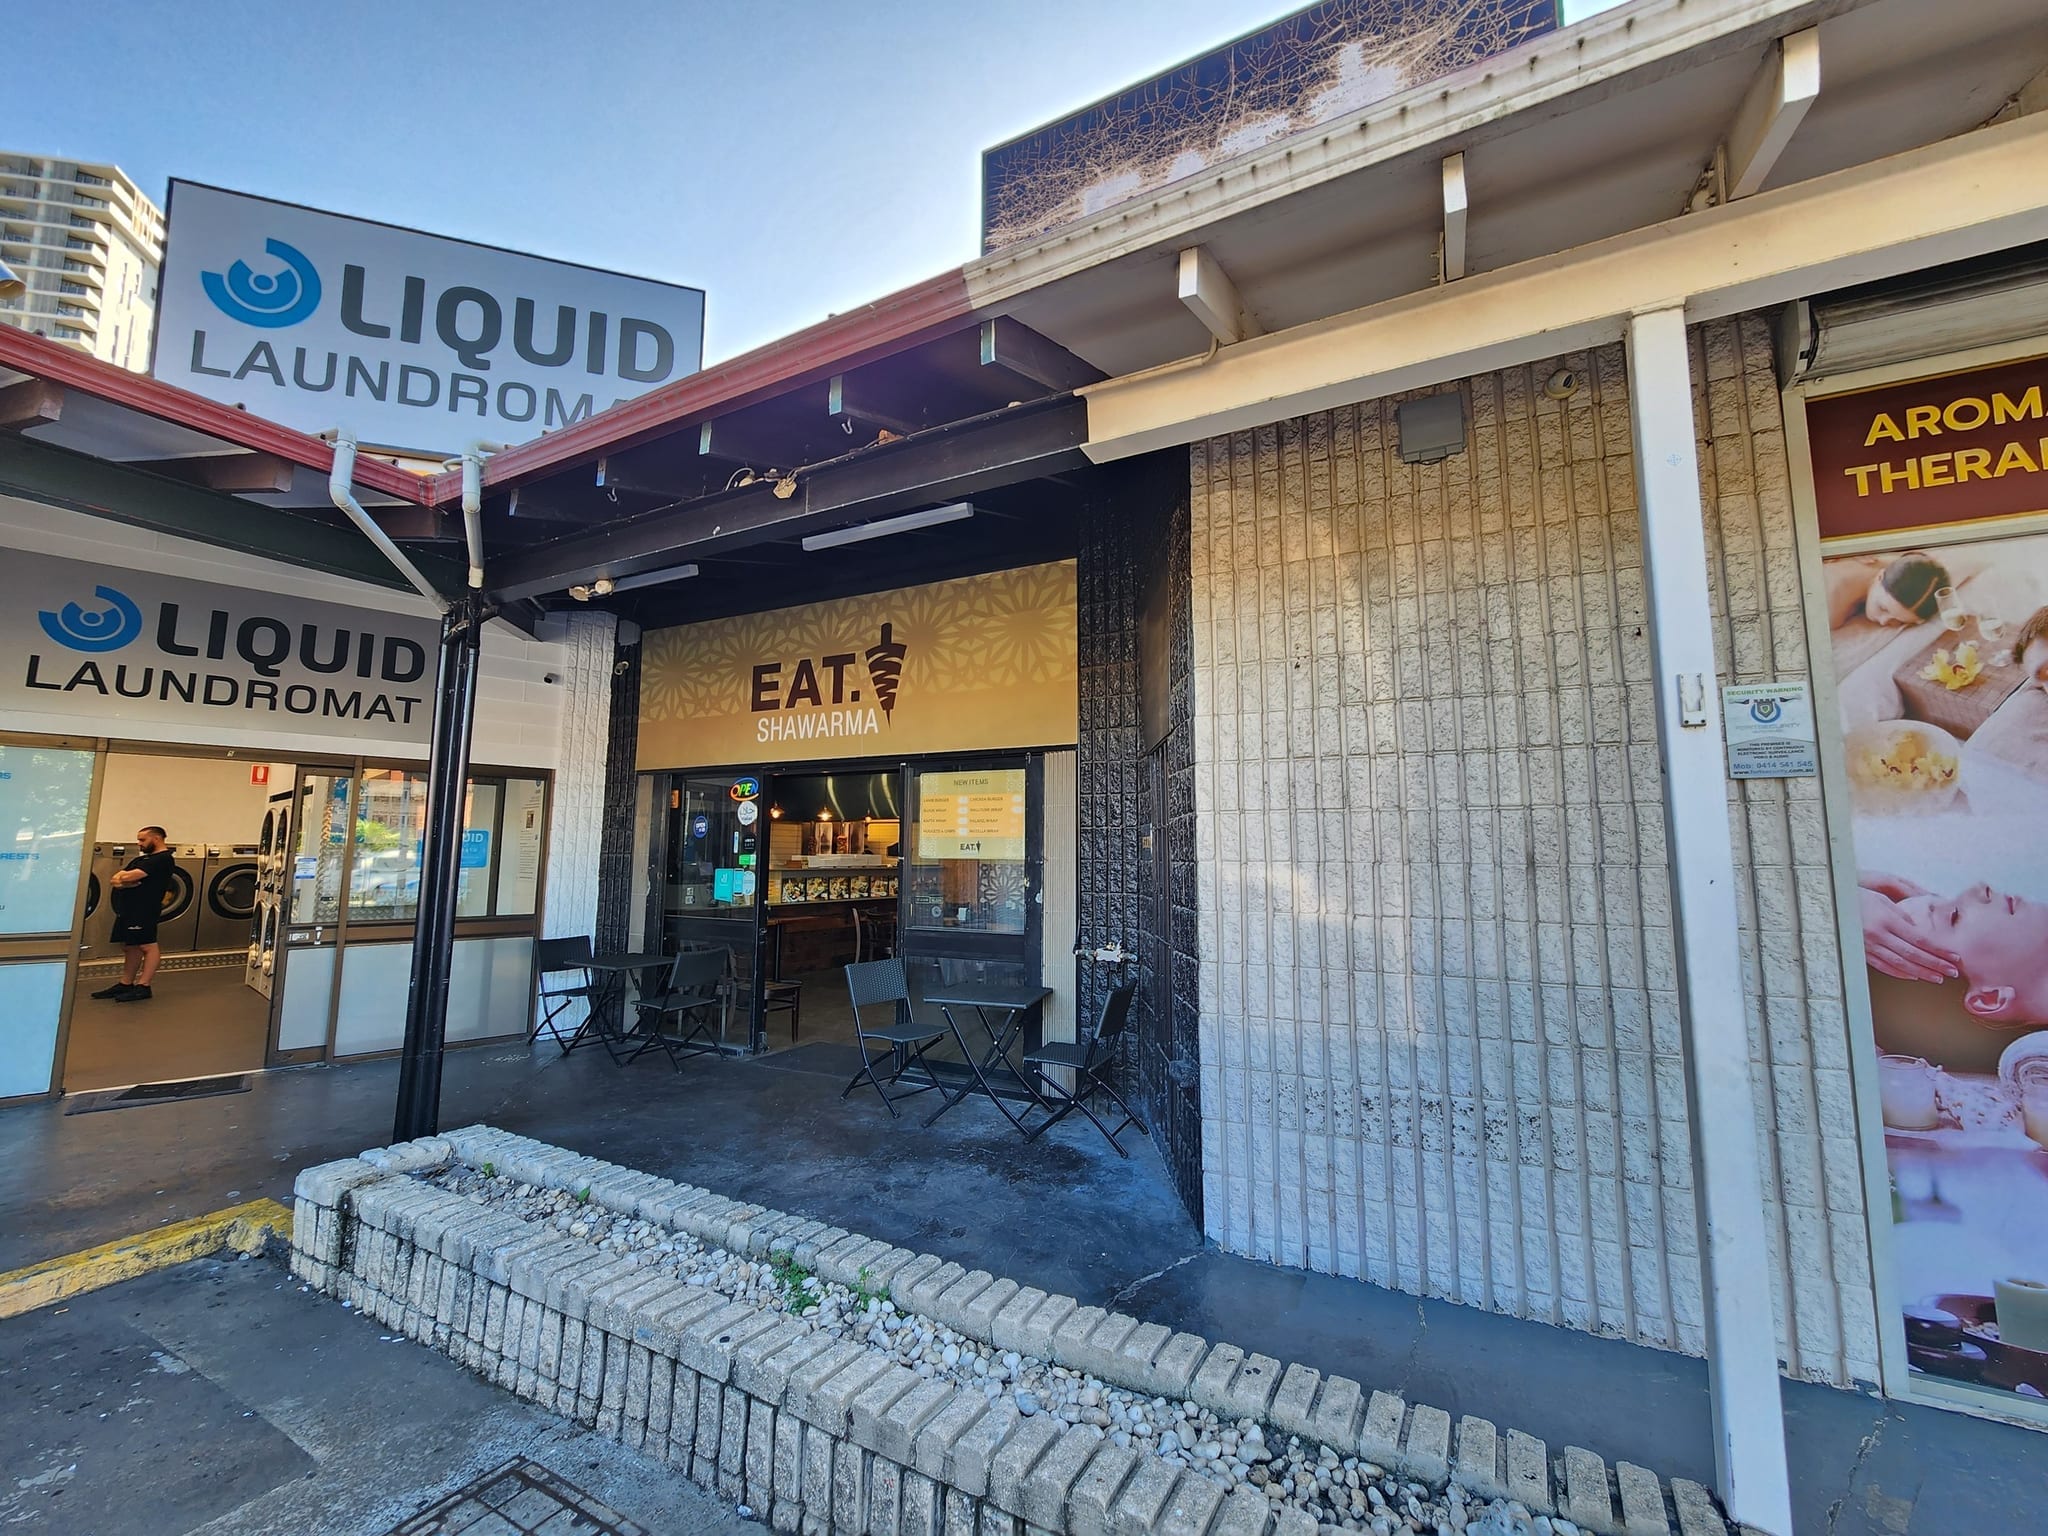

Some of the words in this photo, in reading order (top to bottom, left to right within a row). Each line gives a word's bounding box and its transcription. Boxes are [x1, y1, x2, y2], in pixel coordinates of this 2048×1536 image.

[341, 263, 675, 383] LIQUID
[190, 329, 629, 428] LAUNDROM
[1863, 385, 2048, 447] AROM
[1844, 437, 2048, 497] THERA
[156, 602, 427, 684] LIQUID
[25, 654, 422, 725] LAUNDROMAT
[751, 652, 861, 713] EAT.
[1766, 686, 1803, 694] WARNING
[756, 708, 879, 743] SHAWARMA
[731, 783, 758, 797] OPEN
